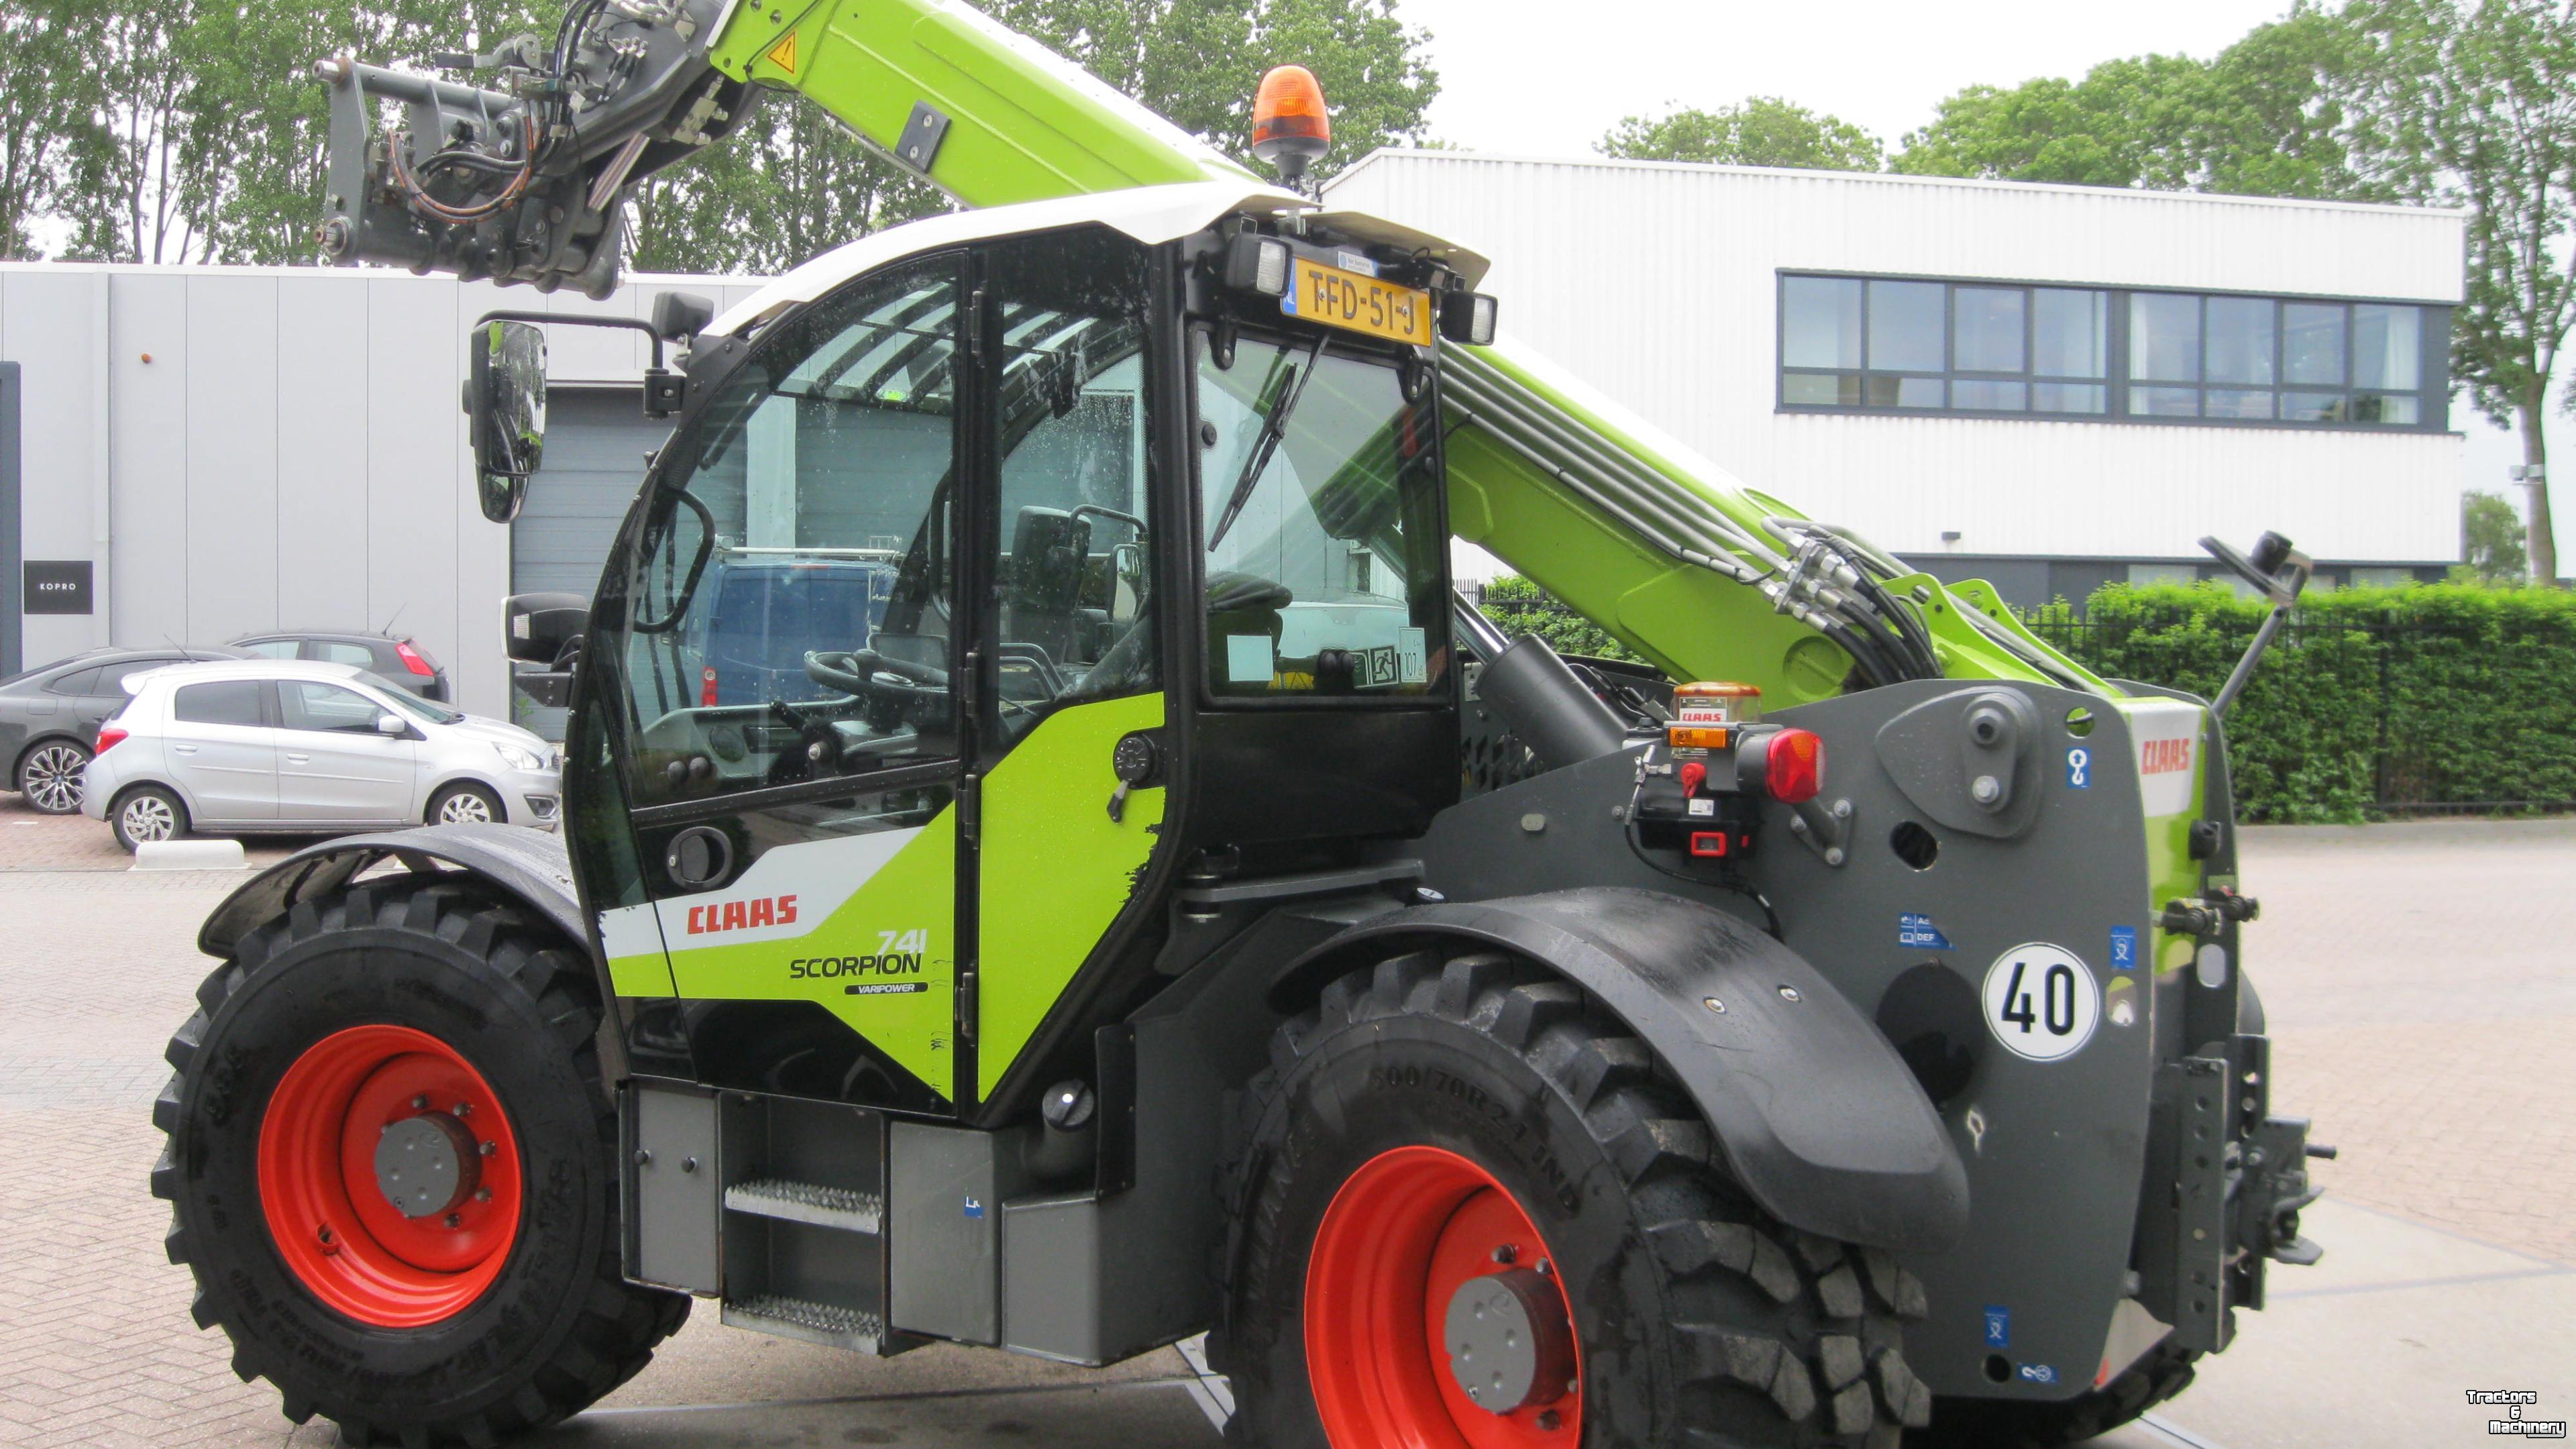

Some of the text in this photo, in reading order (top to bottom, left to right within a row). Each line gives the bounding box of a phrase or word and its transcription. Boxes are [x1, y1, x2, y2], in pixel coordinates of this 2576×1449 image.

[1309, 270, 1415, 335] TFD-51-J
[1682, 712, 1722, 722] CLAAS
[2141, 738, 2190, 775] CLAAS
[688, 894, 797, 934] CLAAS
[877, 928, 928, 955] 741
[1917, 933, 1935, 941] DEF
[790, 953, 922, 979] SCORPION
[858, 983, 915, 994] VARIPOWER
[2001, 962, 2075, 1036] 40
